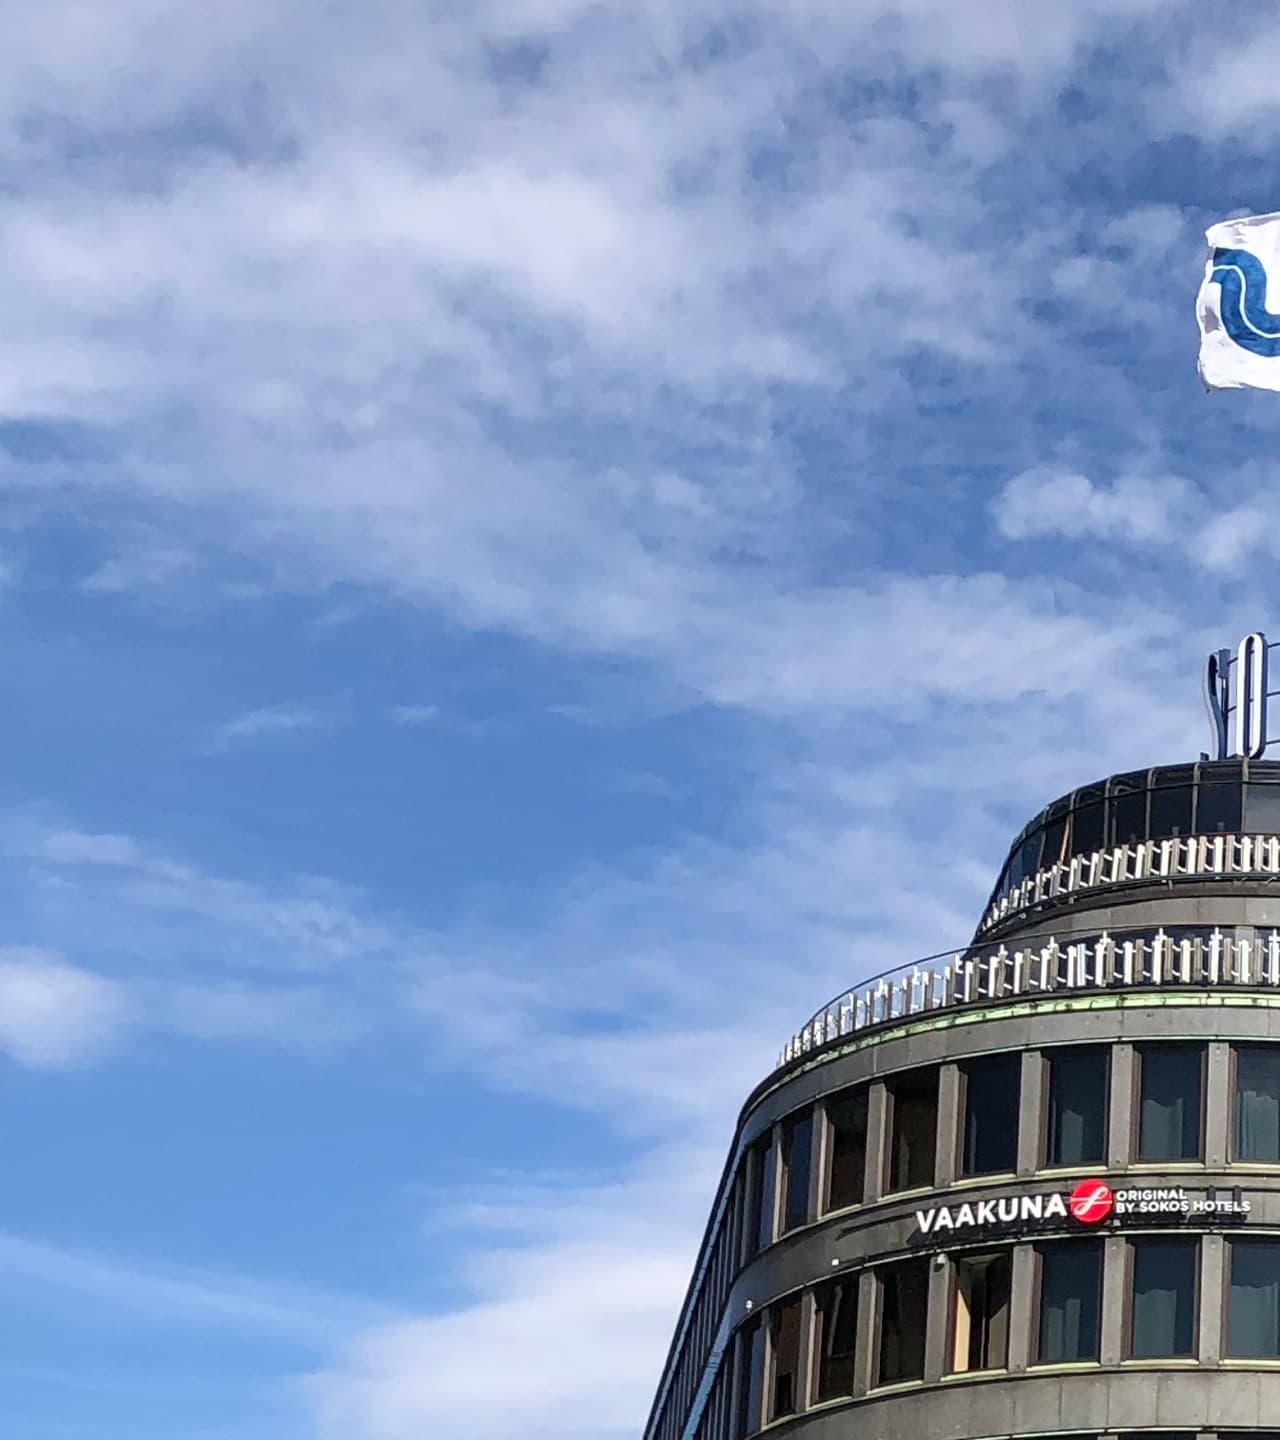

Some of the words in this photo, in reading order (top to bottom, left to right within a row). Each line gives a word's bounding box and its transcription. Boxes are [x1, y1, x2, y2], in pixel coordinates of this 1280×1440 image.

[1116, 1189, 1188, 1201] ORIGINAL
[1116, 1202, 1137, 1213] BY
[1139, 1200, 1189, 1212] SOKOS
[1193, 1200, 1251, 1212] HOTELS
[916, 1194, 1067, 1233] VAAKUNA
